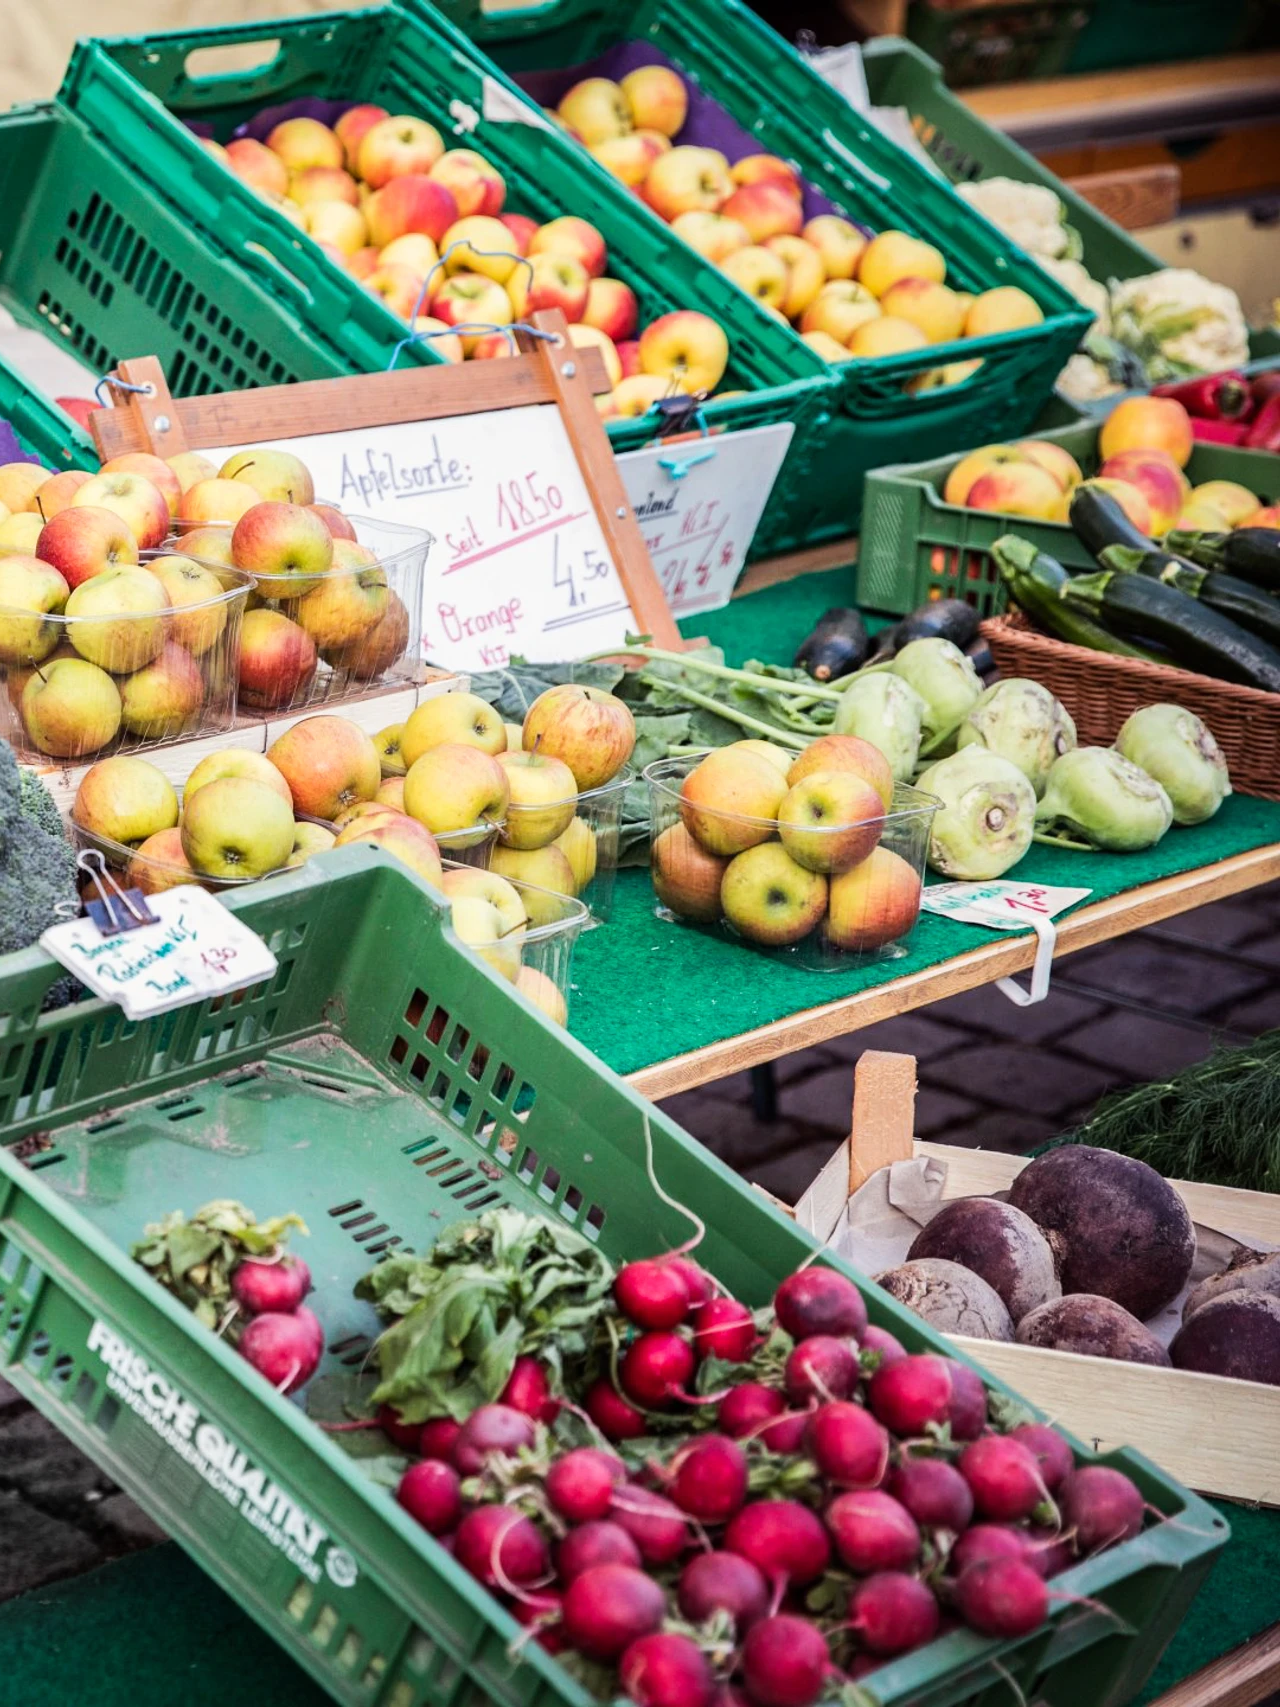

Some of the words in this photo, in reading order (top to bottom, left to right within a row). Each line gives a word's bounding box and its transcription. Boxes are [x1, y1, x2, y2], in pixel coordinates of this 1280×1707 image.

[445, 516, 484, 559] Seit
[497, 471, 563, 531] 1850
[437, 597, 525, 643] Orange
[86, 1318, 201, 1441] FRISCHE
